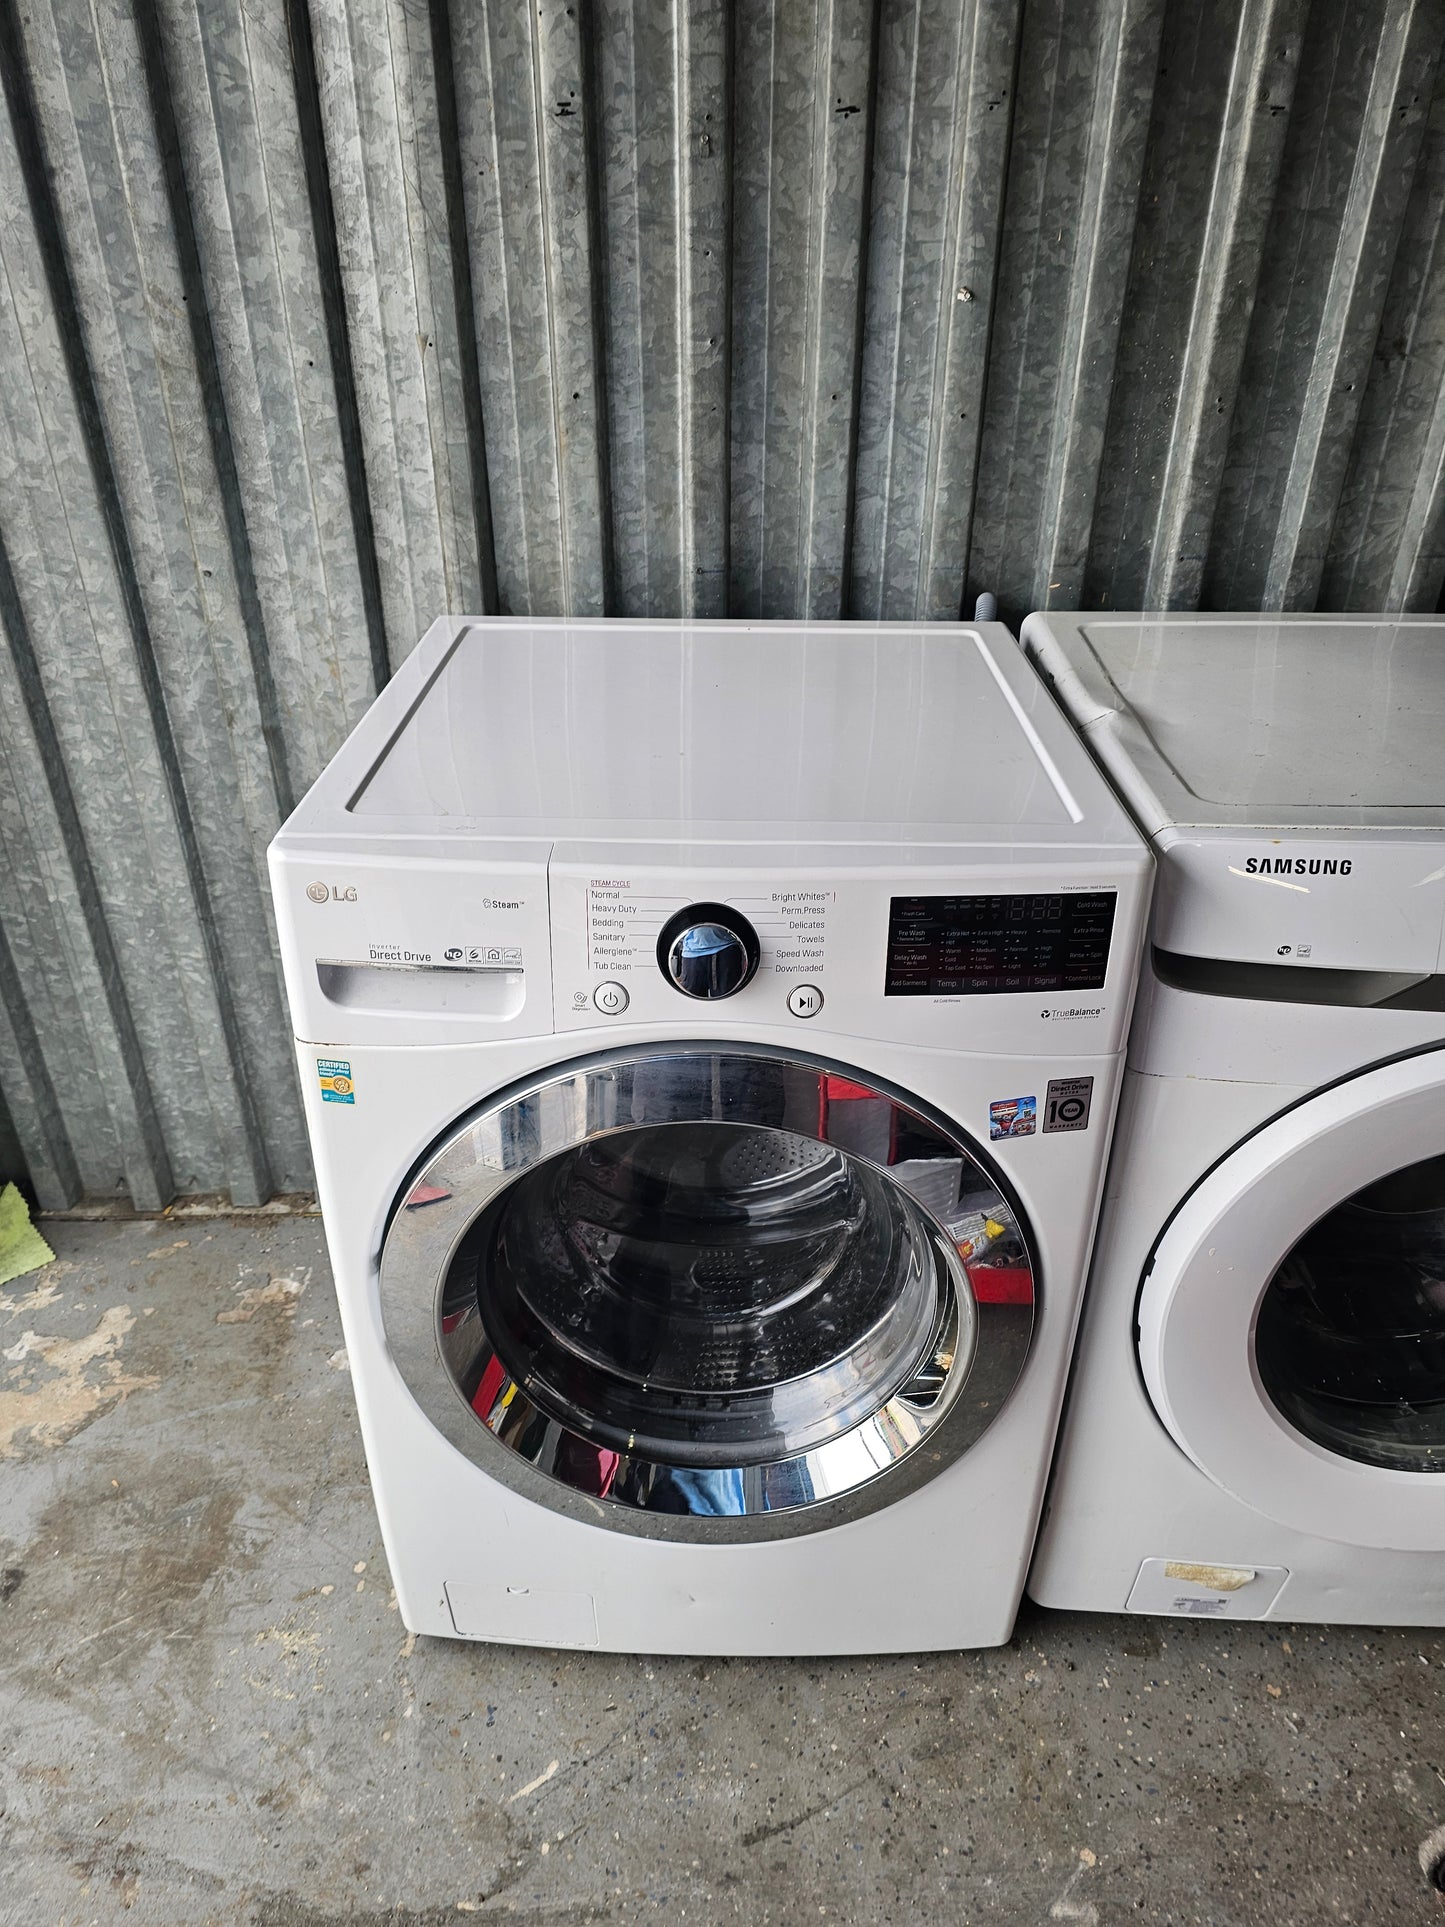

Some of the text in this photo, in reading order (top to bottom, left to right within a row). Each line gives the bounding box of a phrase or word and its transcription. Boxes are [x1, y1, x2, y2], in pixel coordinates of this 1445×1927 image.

[1245, 858, 1353, 875] SAMSUNG
[590, 879, 631, 888] STEAM CYCLE
[332, 886, 358, 902] LG
[591, 890, 620, 899] Normal
[771, 893, 796, 902] Bright
[592, 904, 637, 914] Heavy Duty
[592, 918, 624, 928] Bedding
[789, 921, 825, 929] Delicates
[592, 932, 626, 942] Sanitary
[796, 935, 825, 943] Towels
[369, 949, 432, 962] Direct Drive
[776, 949, 824, 959] Speed Wash
[594, 961, 632, 971] Tub Clean
[775, 964, 824, 973] Downloaded
[937, 980, 959, 988] Temp.
[971, 979, 988, 988] Spin
[1006, 978, 1020, 986] Soil
[1034, 977, 1057, 986] Signal
[318, 1060, 350, 1070] CERTIFIED
[1071, 1083, 1089, 1091] Drive
[1050, 1098, 1085, 1123] 10
